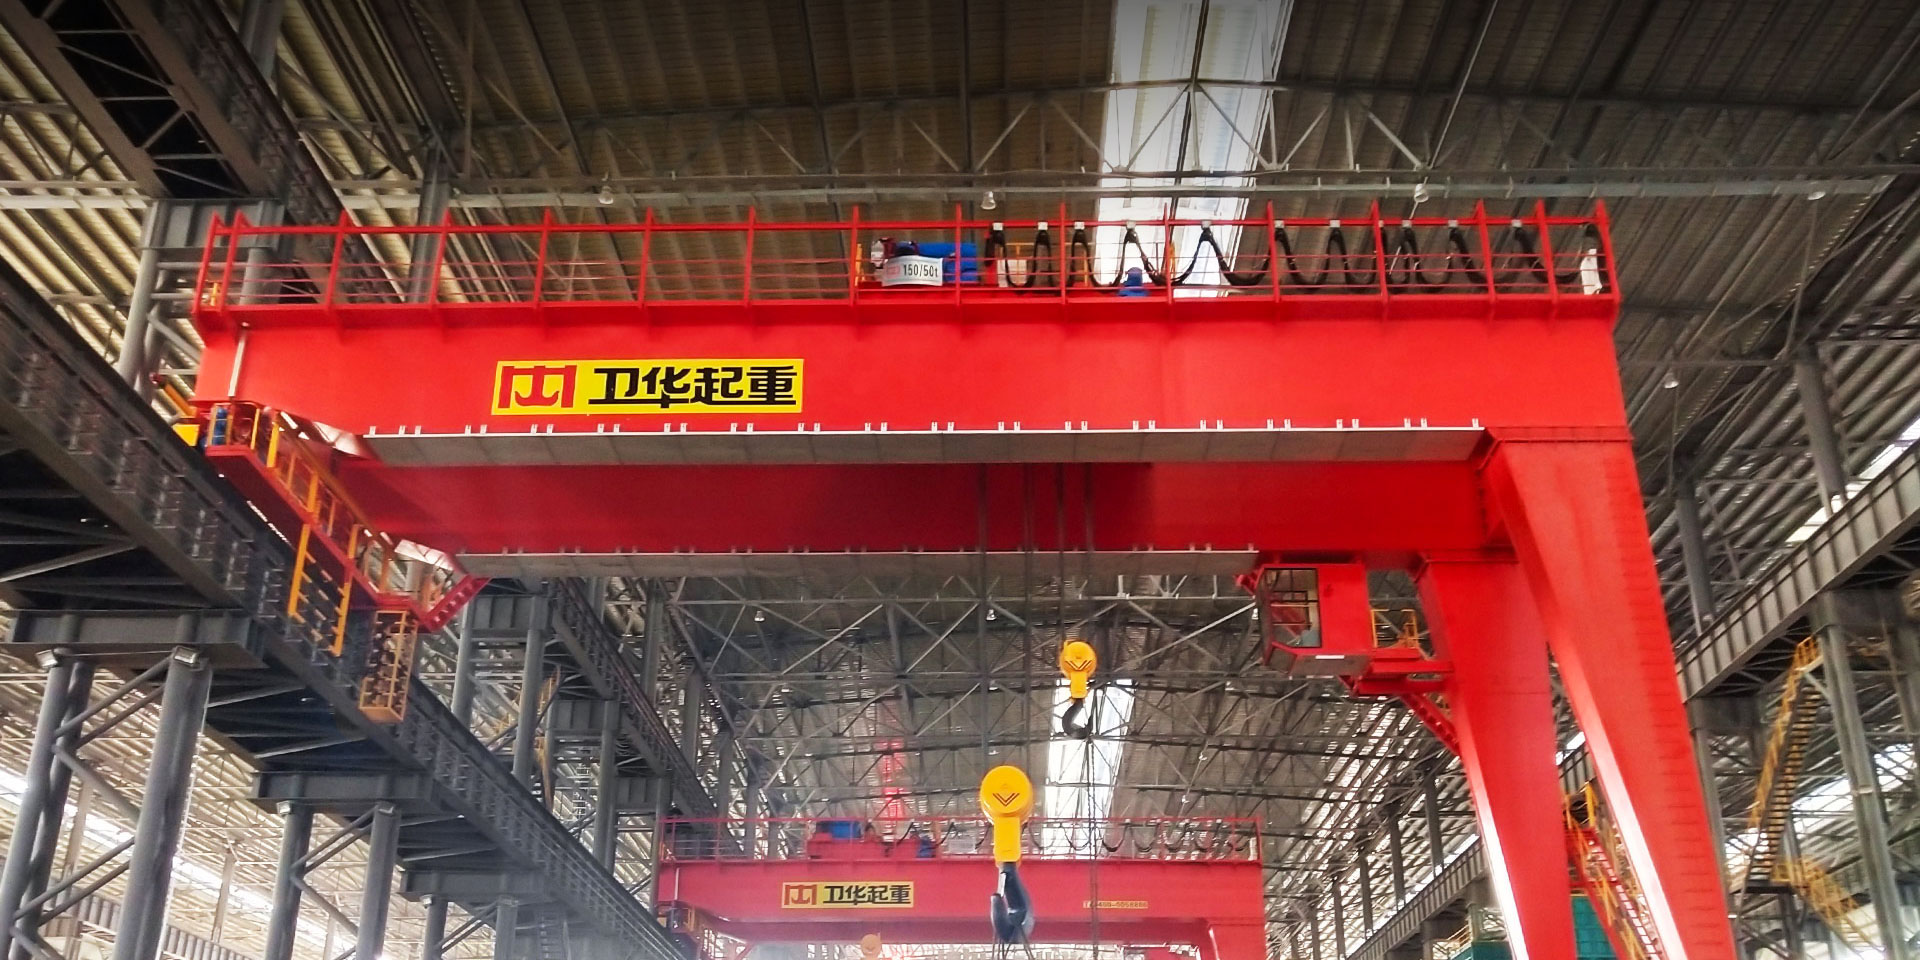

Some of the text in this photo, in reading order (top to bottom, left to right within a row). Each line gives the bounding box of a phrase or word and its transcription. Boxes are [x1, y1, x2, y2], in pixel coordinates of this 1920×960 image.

[903, 264, 938, 277] 150/50t
[588, 366, 797, 408] 卫华起重
[823, 885, 911, 905] 卫华起重
